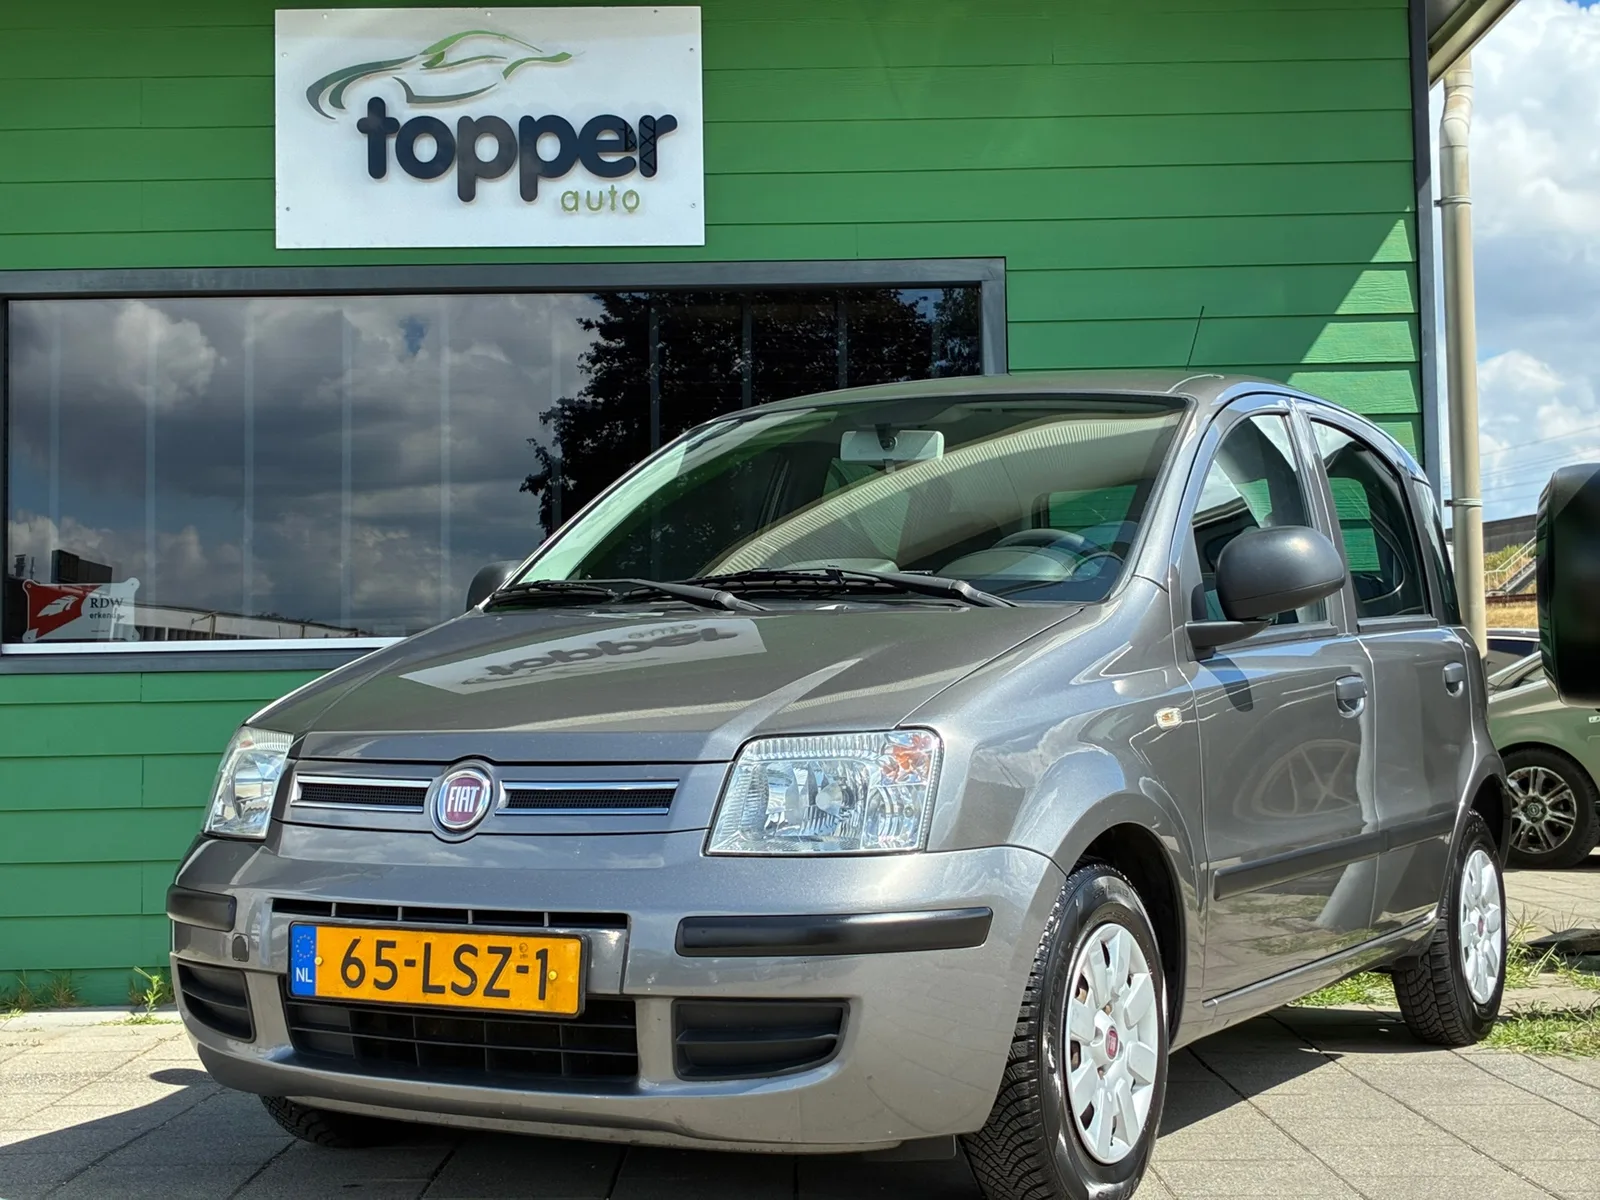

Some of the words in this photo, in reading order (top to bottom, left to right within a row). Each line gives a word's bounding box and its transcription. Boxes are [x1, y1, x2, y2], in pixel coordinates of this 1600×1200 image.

[356, 96, 678, 202] topper
[560, 184, 640, 213] auto
[90, 597, 124, 609] RDW
[447, 785, 480, 813] FIAT
[295, 967, 313, 984] NL
[340, 937, 549, 1001] 65-LSZ-1
